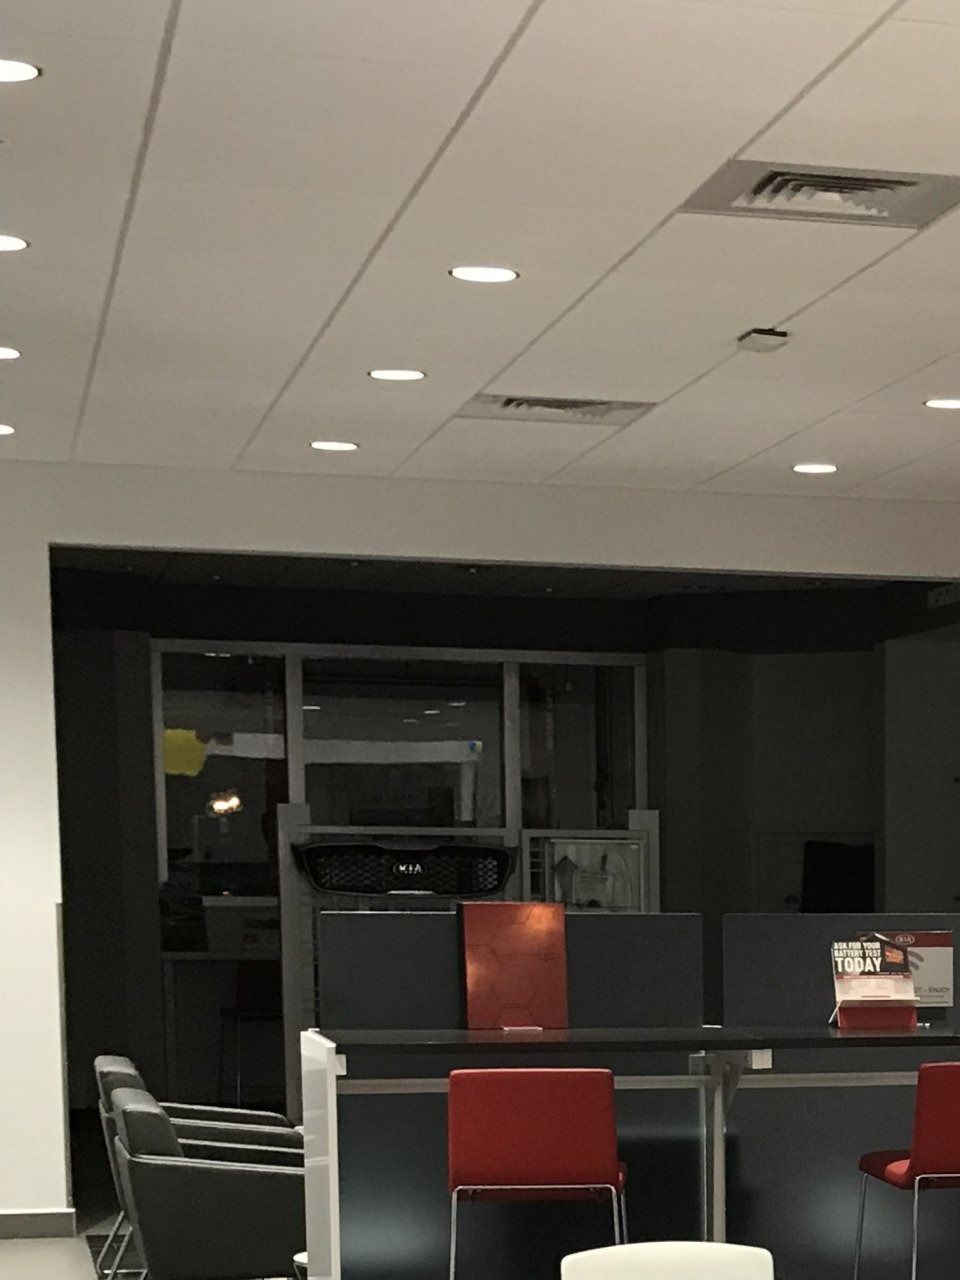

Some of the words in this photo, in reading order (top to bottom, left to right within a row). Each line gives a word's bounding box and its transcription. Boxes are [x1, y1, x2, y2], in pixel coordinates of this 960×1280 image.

[833, 941, 848, 950] ASK
[848, 941, 862, 950] FOR
[862, 941, 881, 950] YOUR
[834, 949, 864, 957] BATTERY
[865, 949, 881, 957] TEST
[834, 957, 882, 973] TODAY
